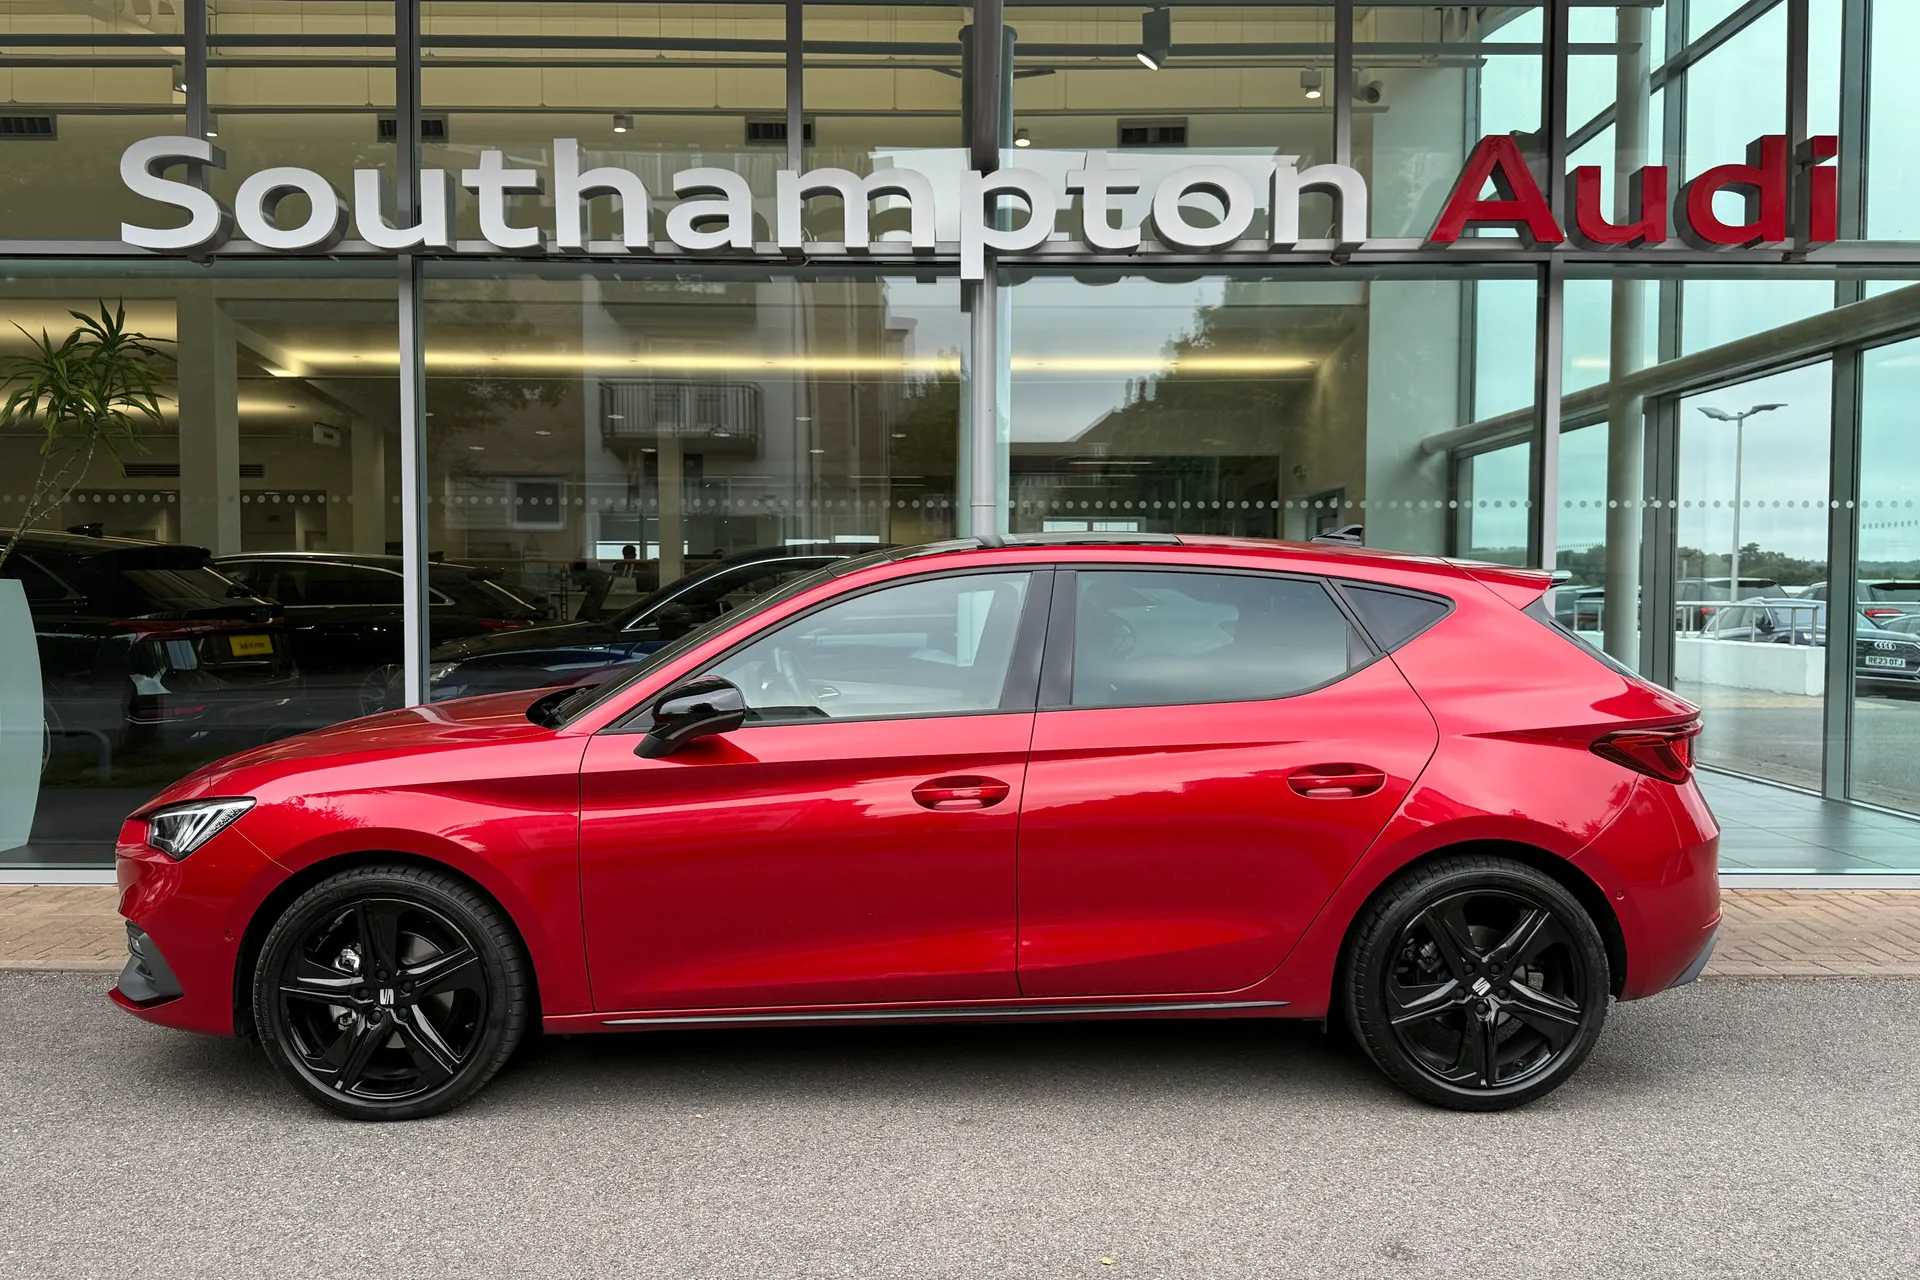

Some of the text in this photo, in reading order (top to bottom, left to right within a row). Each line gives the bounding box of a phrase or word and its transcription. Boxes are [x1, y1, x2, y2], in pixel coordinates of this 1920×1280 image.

[119, 134, 1840, 281] Southampton Audi
[1868, 656, 1888, 665] RE23
